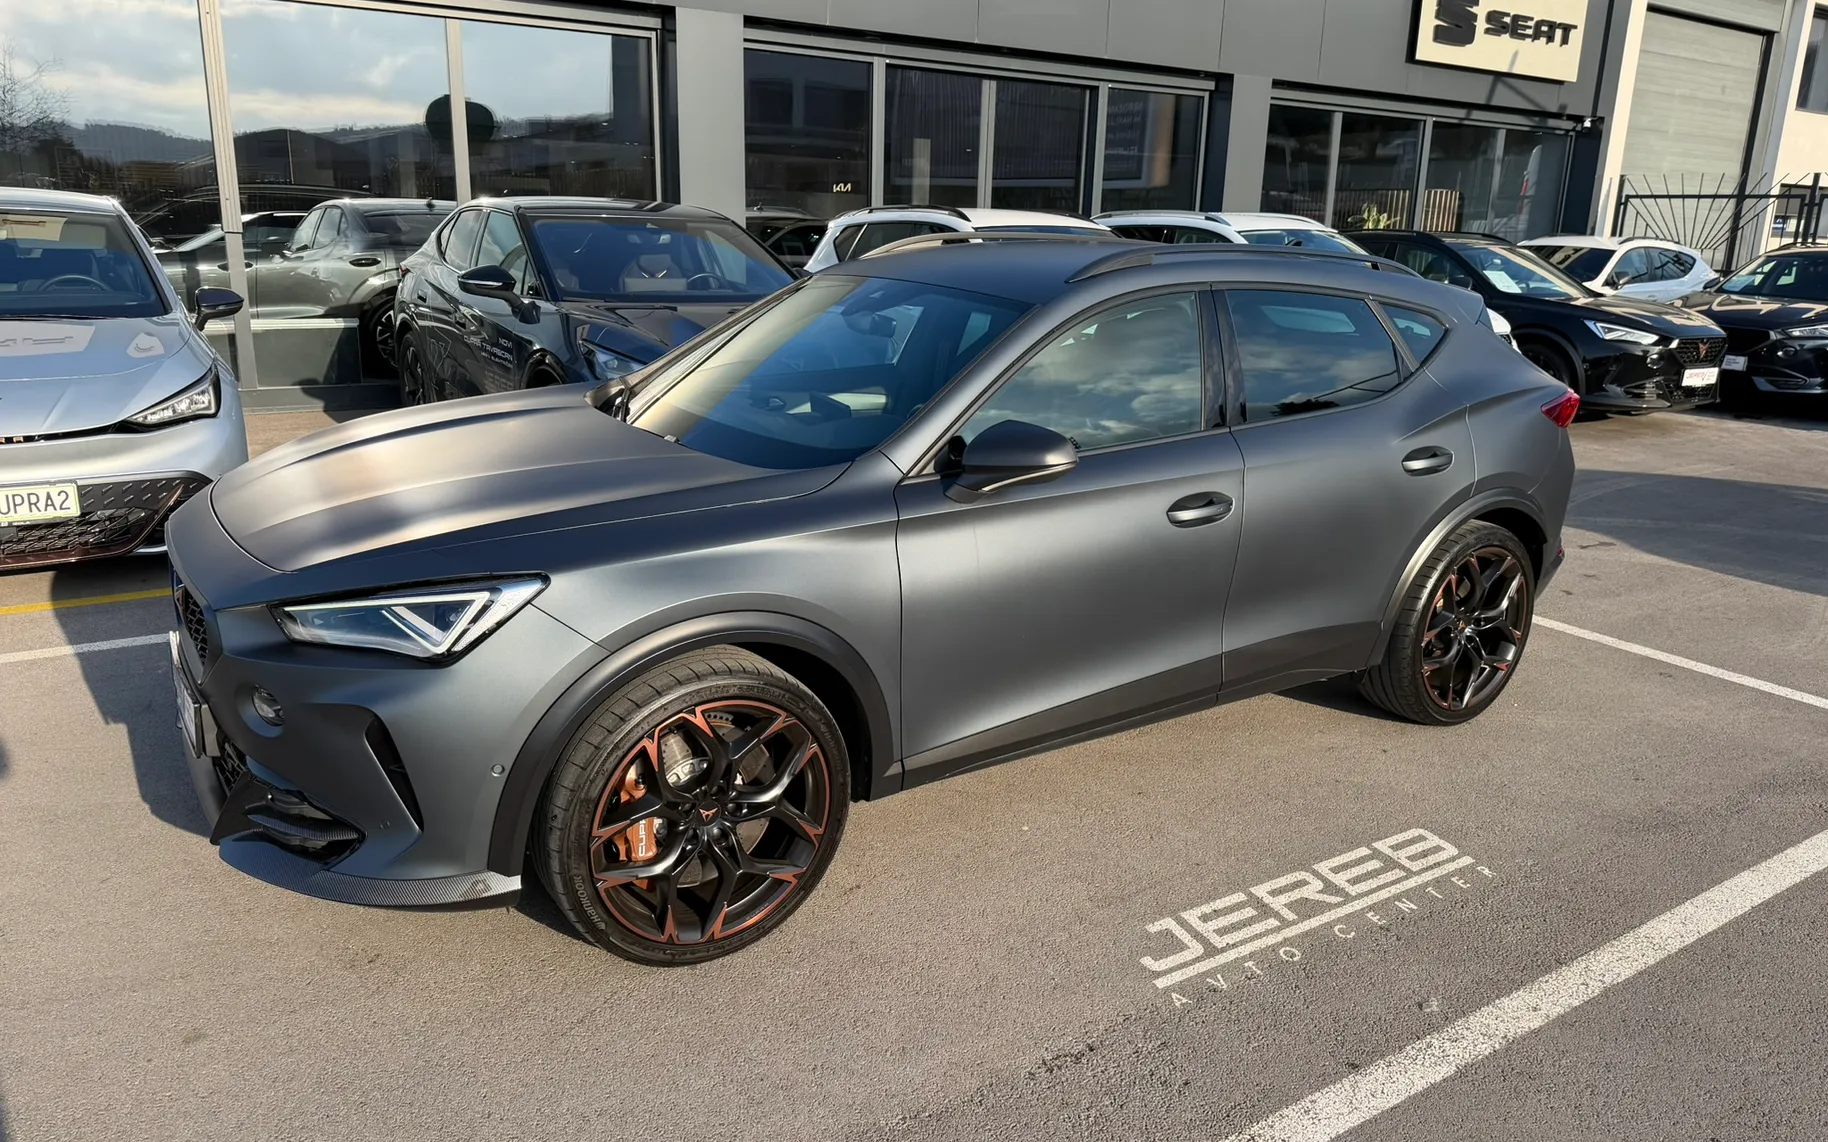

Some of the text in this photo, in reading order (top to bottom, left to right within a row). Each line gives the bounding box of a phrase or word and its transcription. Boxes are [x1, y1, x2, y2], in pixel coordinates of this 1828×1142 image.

[1484, 10, 1578, 47] SEAT
[833, 182, 852, 193] KIA
[498, 337, 513, 349] NOVI
[1139, 827, 1459, 972] JEREB
[1170, 865, 1497, 1008] AVTO CENTER
